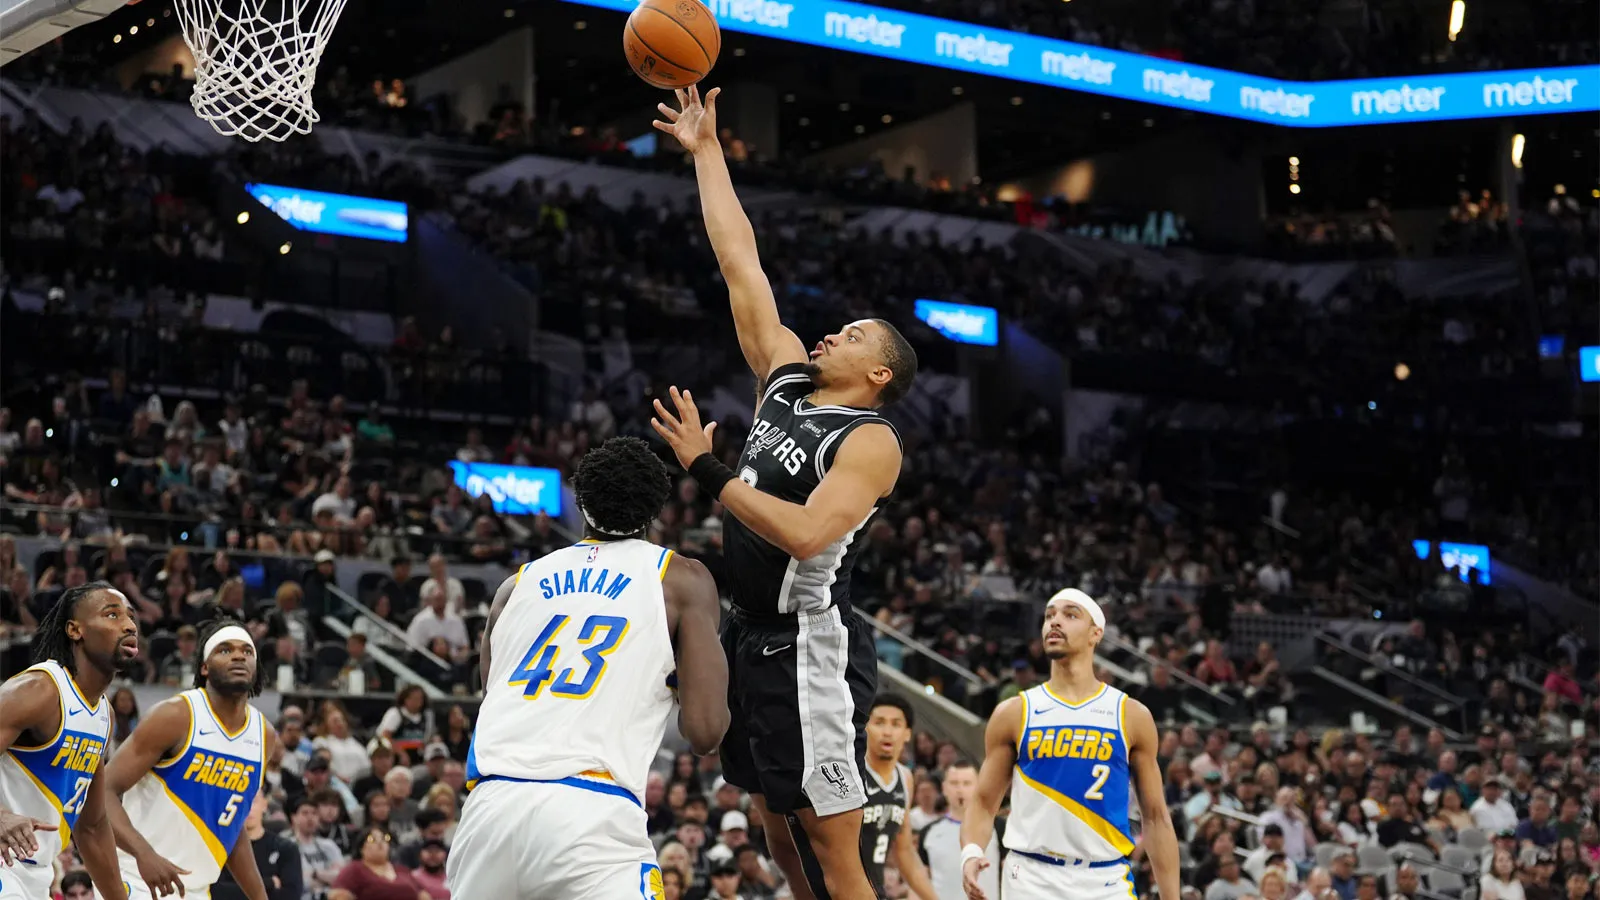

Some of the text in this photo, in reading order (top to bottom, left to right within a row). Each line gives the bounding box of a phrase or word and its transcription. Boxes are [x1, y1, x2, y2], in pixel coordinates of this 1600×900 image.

[825, 11, 906, 48] meter
[935, 31, 1014, 67] meter
[1041, 50, 1116, 85] meter
[1143, 69, 1214, 102] meter
[1239, 85, 1315, 118] meter
[1352, 75, 1579, 116] meter meter
[539, 567, 632, 600] SIAKAM
[507, 614, 631, 701] 43
[50, 735, 104, 775] PACER
[1027, 727, 1116, 762] PACERS
[183, 752, 255, 793] PACERS
[1084, 764, 1110, 800] 2
[217, 793, 244, 827] 5
[873, 834, 889, 863] 2
